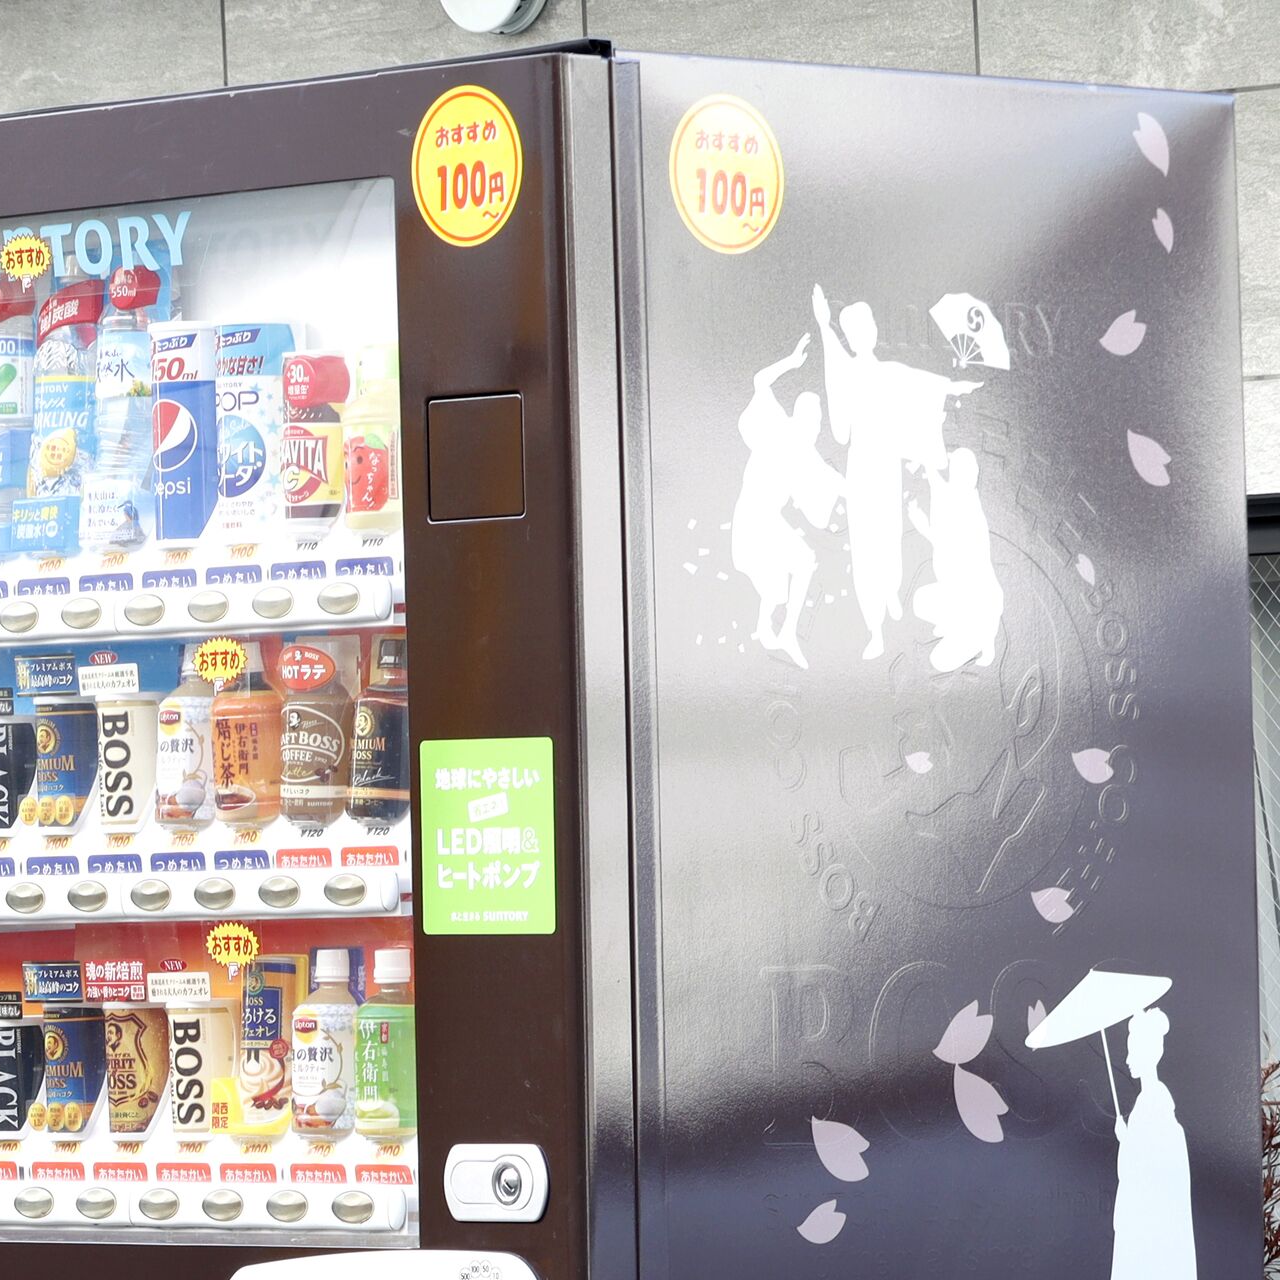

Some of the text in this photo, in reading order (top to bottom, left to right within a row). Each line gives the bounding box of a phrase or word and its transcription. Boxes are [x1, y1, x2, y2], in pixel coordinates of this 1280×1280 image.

[435, 120, 497, 148] おすすめ
[696, 130, 758, 154] おすすめ
[4, 247, 45, 269] おすすめ
[275, 565, 322, 580] つめたい
[340, 562, 389, 576] つめたい
[147, 573, 193, 588] つめたい
[211, 569, 257, 584] つめたい
[22, 584, 66, 597] つめたい
[84, 579, 129, 592] つめたい
[93, 653, 113, 665] NEW
[198, 649, 240, 672] おすすめ
[30, 661, 73, 673] プレミアムボス
[17, 663, 30, 688] 新
[31, 674, 73, 688] 最高峰のコク
[298, 731, 341, 752] BOSS
[215, 718, 236, 789] 焙じ茶
[235, 722, 250, 776] 伊右衛門
[101, 711, 134, 818] BOSS
[435, 767, 541, 790] 地球にやさしい
[300, 827, 323, 838] ¥120
[367, 826, 390, 836] ¥120
[92, 860, 138, 873] つめたい
[155, 857, 202, 872] つめたい
[219, 855, 266, 870] つめたい
[280, 854, 328, 868] あたたかい
[346, 852, 394, 867] あたたかい
[31, 862, 76, 876] つめたい
[437, 860, 541, 891] ヒートポンプ
[482, 911, 529, 922] SUNTORY
[211, 936, 253, 956] おすすめ
[85, 962, 144, 981] 魂の新焙煎
[163, 960, 184, 971] NEW
[25, 968, 38, 995] 新
[38, 969, 80, 980] プレミアムボス
[38, 982, 80, 996] 最高峰のコク
[86, 985, 131, 999] 力強い香りとコク
[358, 1018, 379, 1102] 伊右衛門
[172, 1018, 206, 1126] BOSS
[212, 1102, 228, 1115] 関西
[212, 1116, 229, 1129] 限定
[37, 1168, 81, 1181] あたたかい
[98, 1168, 143, 1181] あたたかい
[161, 1169, 207, 1182] あたたかい
[225, 1169, 272, 1183] あたたかい
[295, 1170, 342, 1184] あたたかい
[361, 1171, 408, 1184] あたたかい
